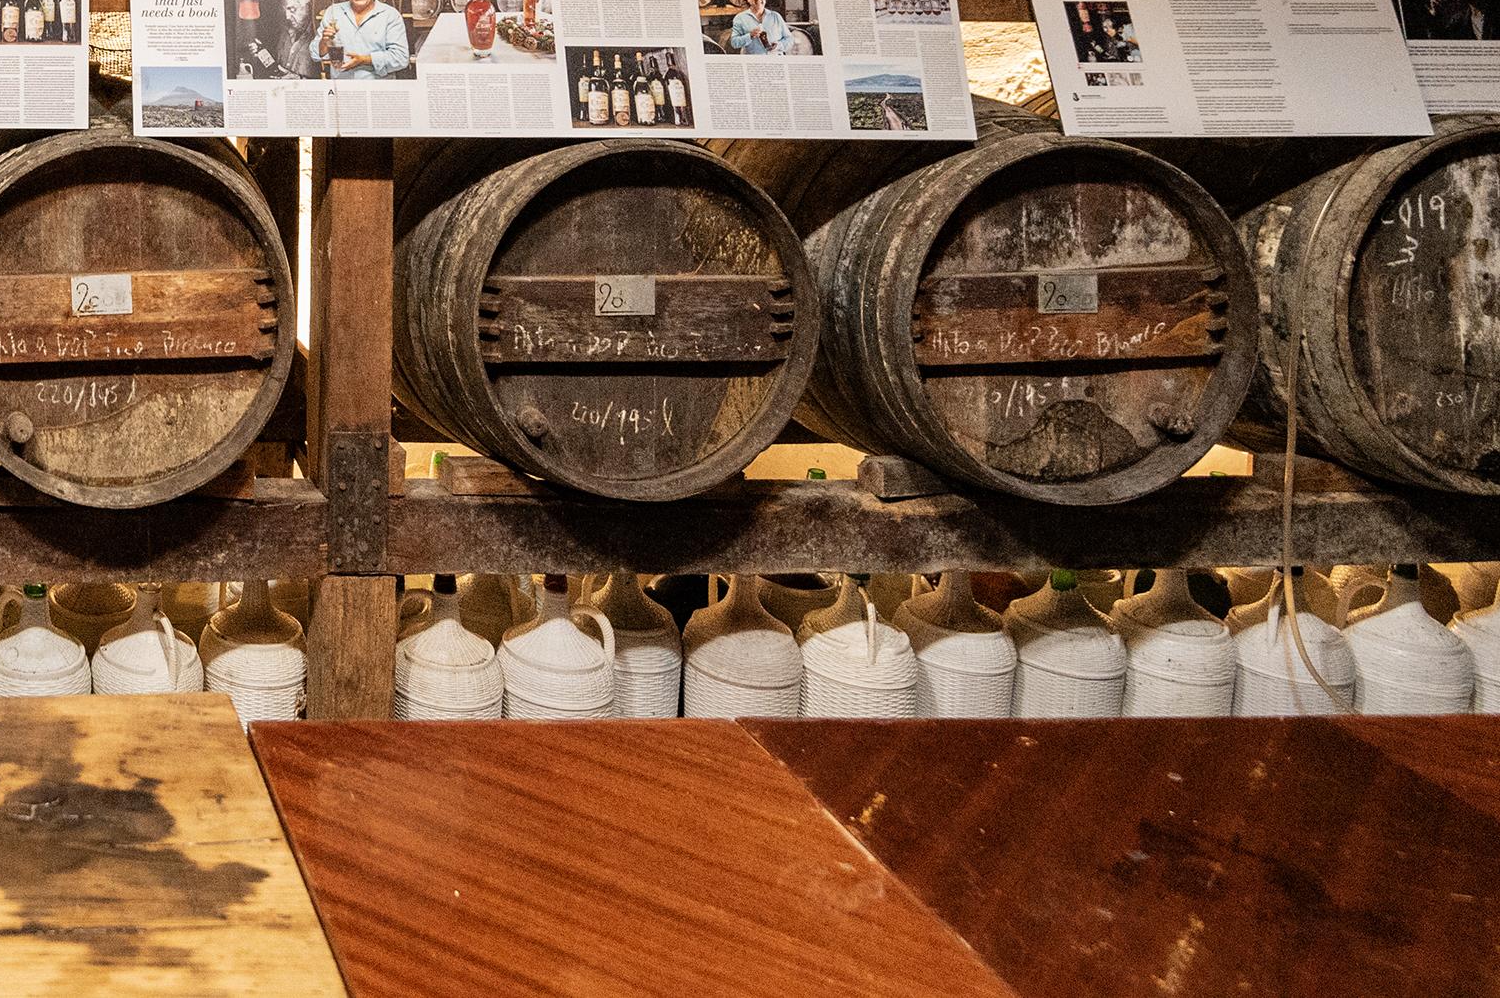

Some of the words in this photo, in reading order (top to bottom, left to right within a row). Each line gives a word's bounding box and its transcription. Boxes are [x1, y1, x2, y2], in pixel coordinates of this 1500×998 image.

[141, 7, 174, 18] needs
[177, 10, 185, 18] a
[188, 7, 218, 18] book
